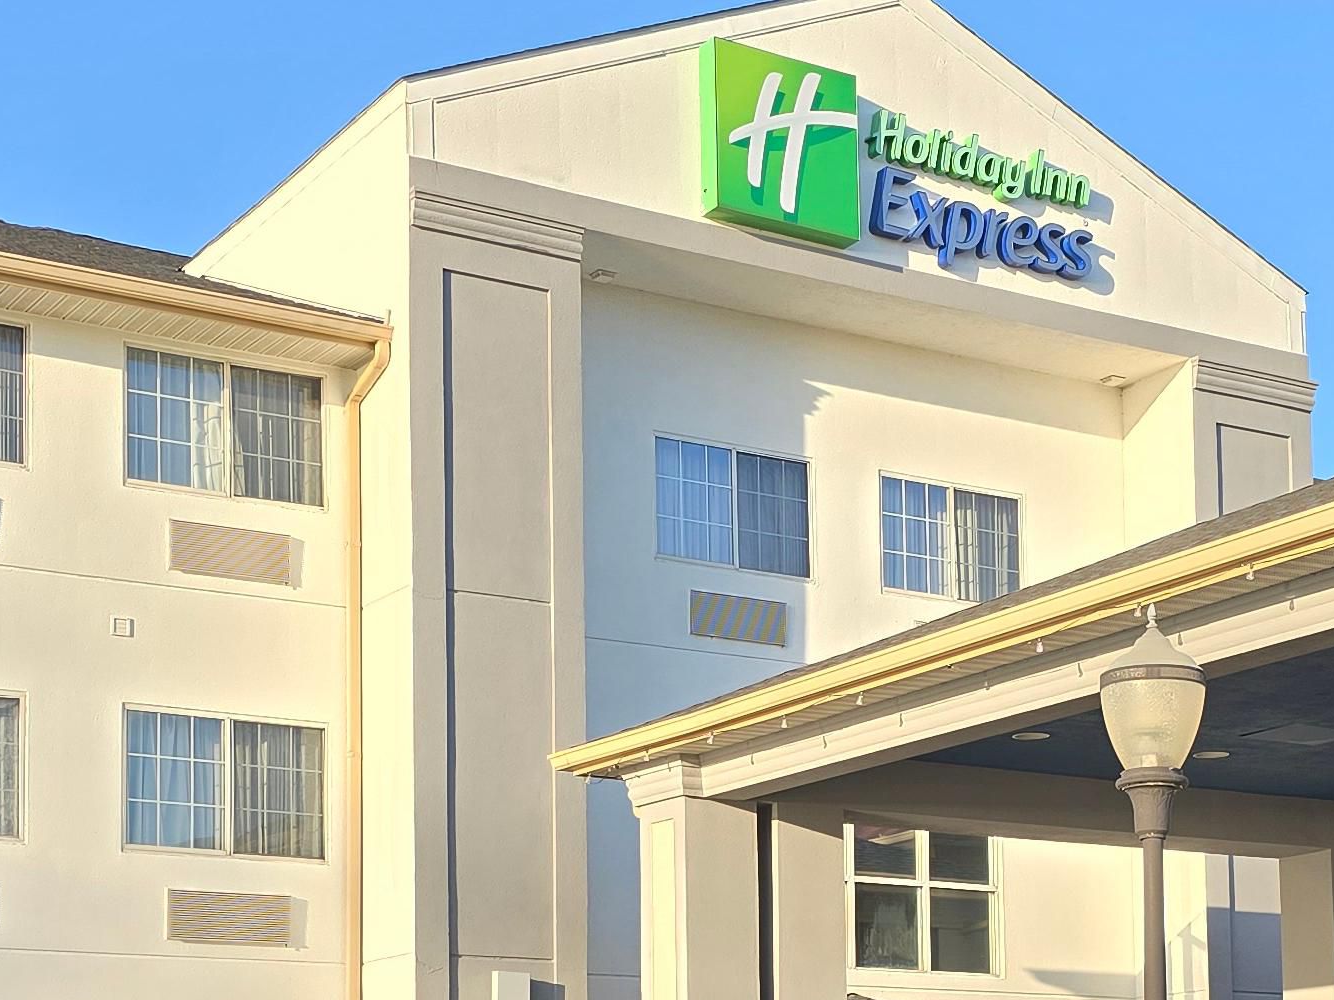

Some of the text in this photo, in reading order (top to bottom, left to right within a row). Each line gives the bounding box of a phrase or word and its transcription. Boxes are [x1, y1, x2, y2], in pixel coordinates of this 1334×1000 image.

[869, 108, 1091, 208] Holiday Inn
[869, 166, 1095, 280] Express
